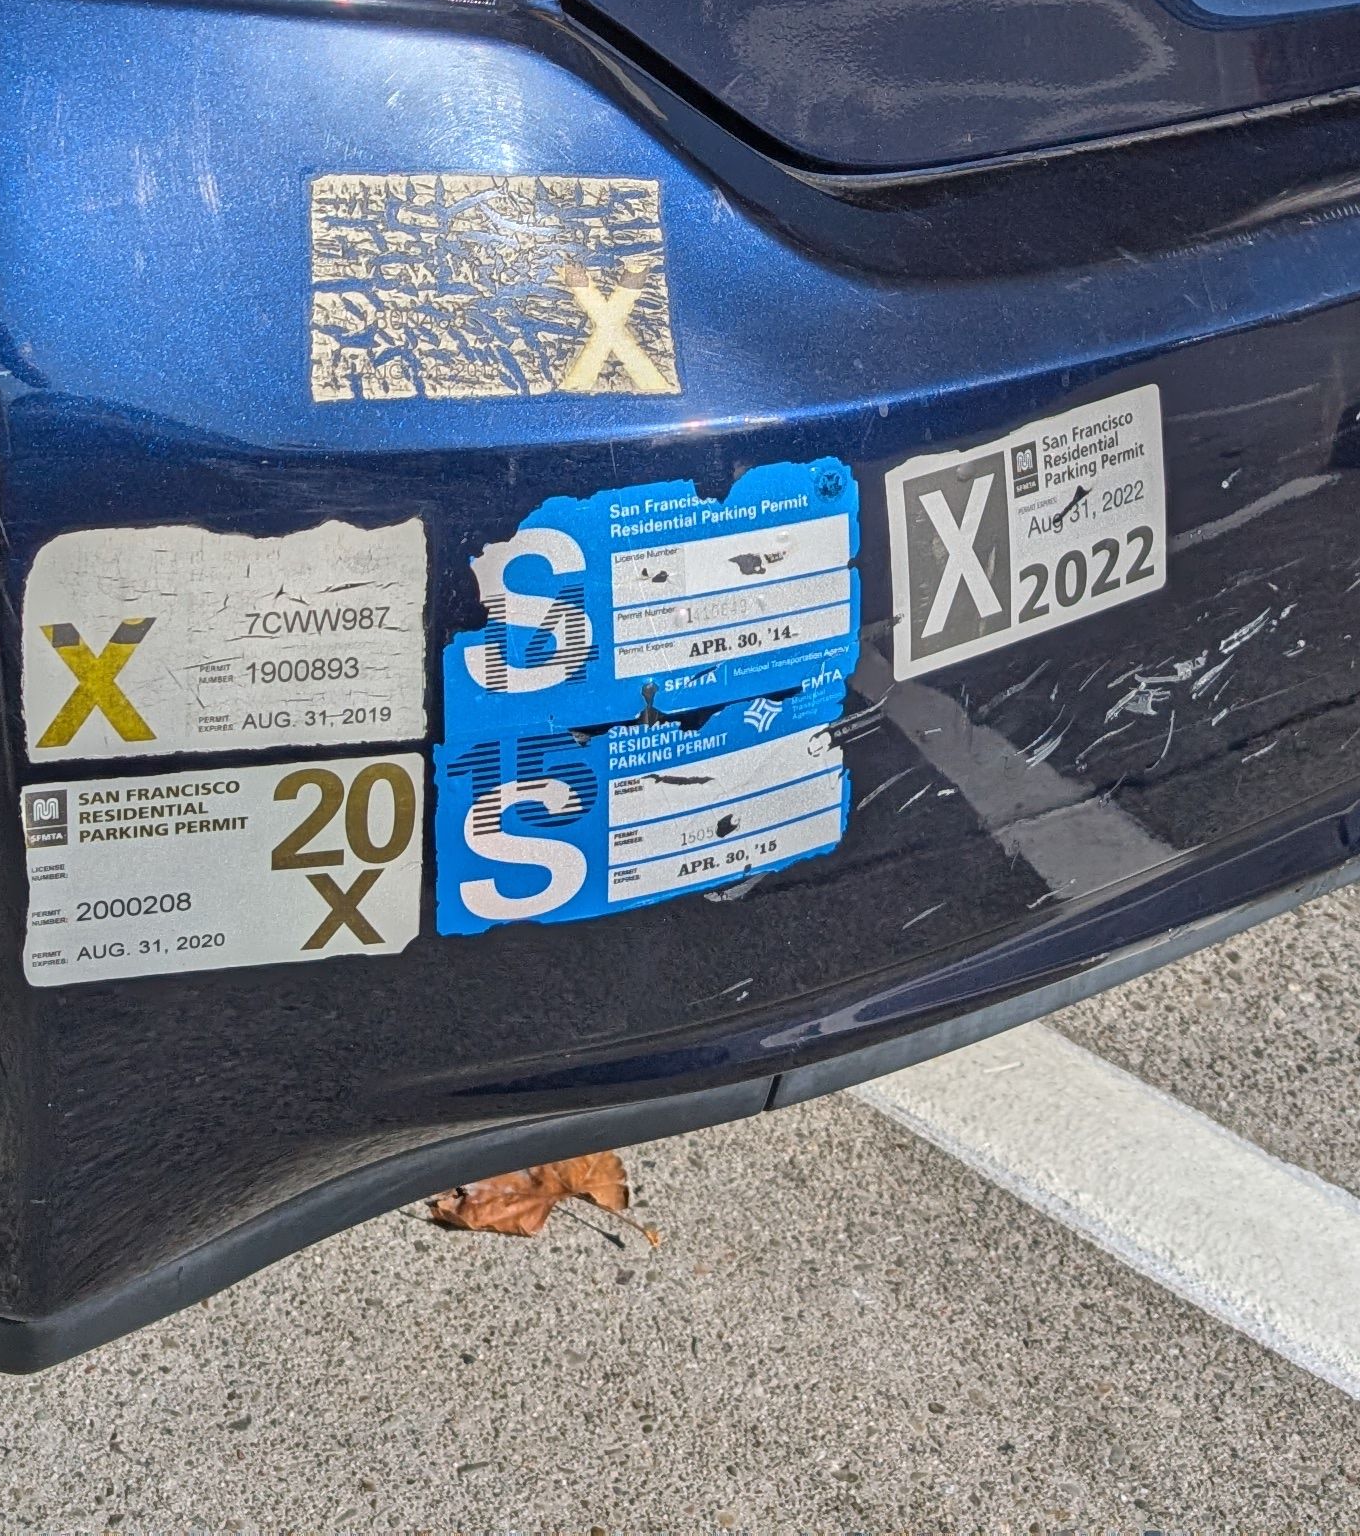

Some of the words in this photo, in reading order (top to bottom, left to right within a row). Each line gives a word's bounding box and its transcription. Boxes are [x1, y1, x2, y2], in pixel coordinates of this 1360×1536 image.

[560, 259, 672, 392] X
[1042, 434, 1068, 452] San
[1072, 412, 1133, 442] Francisco
[1044, 431, 1118, 469] Residential
[1045, 461, 1097, 488] Parking
[1101, 442, 1144, 469] Permit
[610, 503, 640, 519] San
[611, 514, 696, 538] Residential
[702, 506, 757, 523] Parking
[761, 494, 809, 514] Permit
[1028, 512, 1063, 538] Aug
[1070, 498, 1096, 522] 31,
[1102, 480, 1144, 512] 2022
[915, 473, 1002, 638] X
[1019, 525, 1155, 623] 2022
[245, 607, 390, 636] 7CWW987
[464, 527, 593, 693] S
[689, 637, 732, 657] APR.
[738, 632, 762, 648] 30,
[768, 625, 791, 641] '14
[199, 664, 231, 673] PERMIT
[246, 657, 360, 684] 1900893
[733, 662, 770, 677] Municipal
[771, 651, 822, 671] Transportation
[35, 617, 157, 749] X
[664, 671, 718, 692] SFMTA
[241, 711, 296, 730] AUG.
[305, 710, 334, 727] 31,
[342, 706, 392, 725] 2019
[608, 724, 639, 739] SAN
[609, 730, 700, 754] RESIDENTIAL
[610, 746, 672, 771] PARKING
[676, 732, 728, 757] PERMIT
[78, 790, 120, 806] SAN
[126, 780, 240, 802] FRANCISCO
[447, 732, 599, 837] 15
[79, 802, 209, 824] RESIDENTIAL
[271, 762, 417, 871] 20
[30, 833, 64, 843] SFMTA
[79, 823, 169, 843] PARKING
[175, 816, 249, 835] PERMIT
[460, 778, 587, 921] S
[678, 856, 720, 877] APR.
[726, 849, 750, 864] 30,
[755, 840, 777, 855] '15
[32, 909, 62, 918] PERMIT
[76, 892, 192, 922] 2000208
[300, 868, 386, 951] X
[32, 950, 62, 959] PERMIT
[76, 942, 131, 962] AUG.
[138, 939, 169, 955] 31,
[176, 933, 226, 951] 2020
